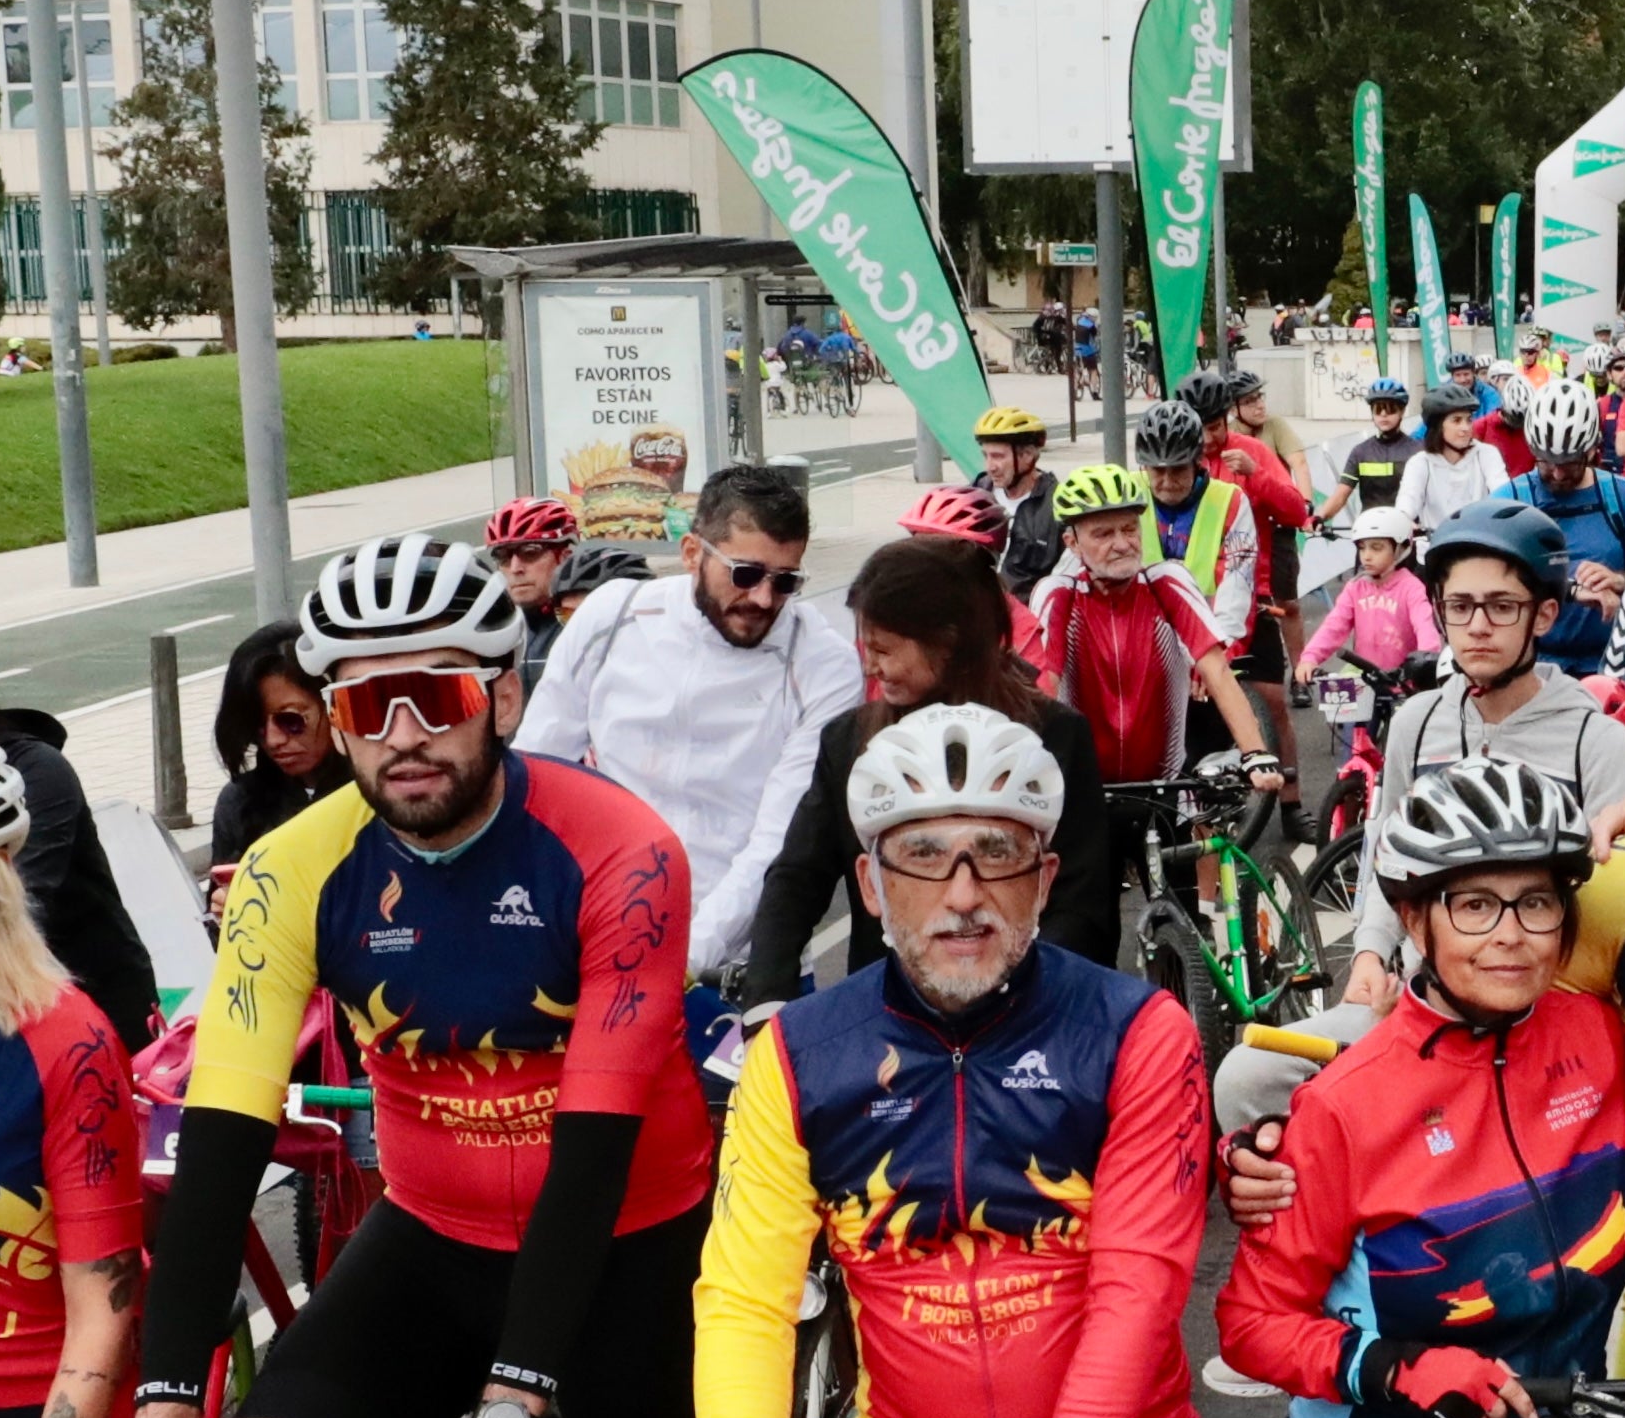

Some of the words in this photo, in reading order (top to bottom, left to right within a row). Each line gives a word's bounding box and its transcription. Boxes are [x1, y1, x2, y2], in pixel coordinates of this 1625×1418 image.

[1163, 123, 1212, 232] Corte
[1157, 231, 1200, 269] El
[604, 345, 639, 360] TUS
[575, 366, 671, 382] FAVORITOS
[596, 384, 652, 403] ESTÁN
[592, 410, 616, 425] DE
[618, 409, 660, 424] CINE
[634, 436, 684, 458] Coca-Cola
[431, 1085, 560, 1119] TRIATLÓ
[1545, 1098, 1590, 1121] AMIGOS
[452, 1129, 553, 1149] VALLADOL
[918, 1290, 1041, 1326] BOMBEROS
[925, 1315, 1038, 1345] VALLADOLID
